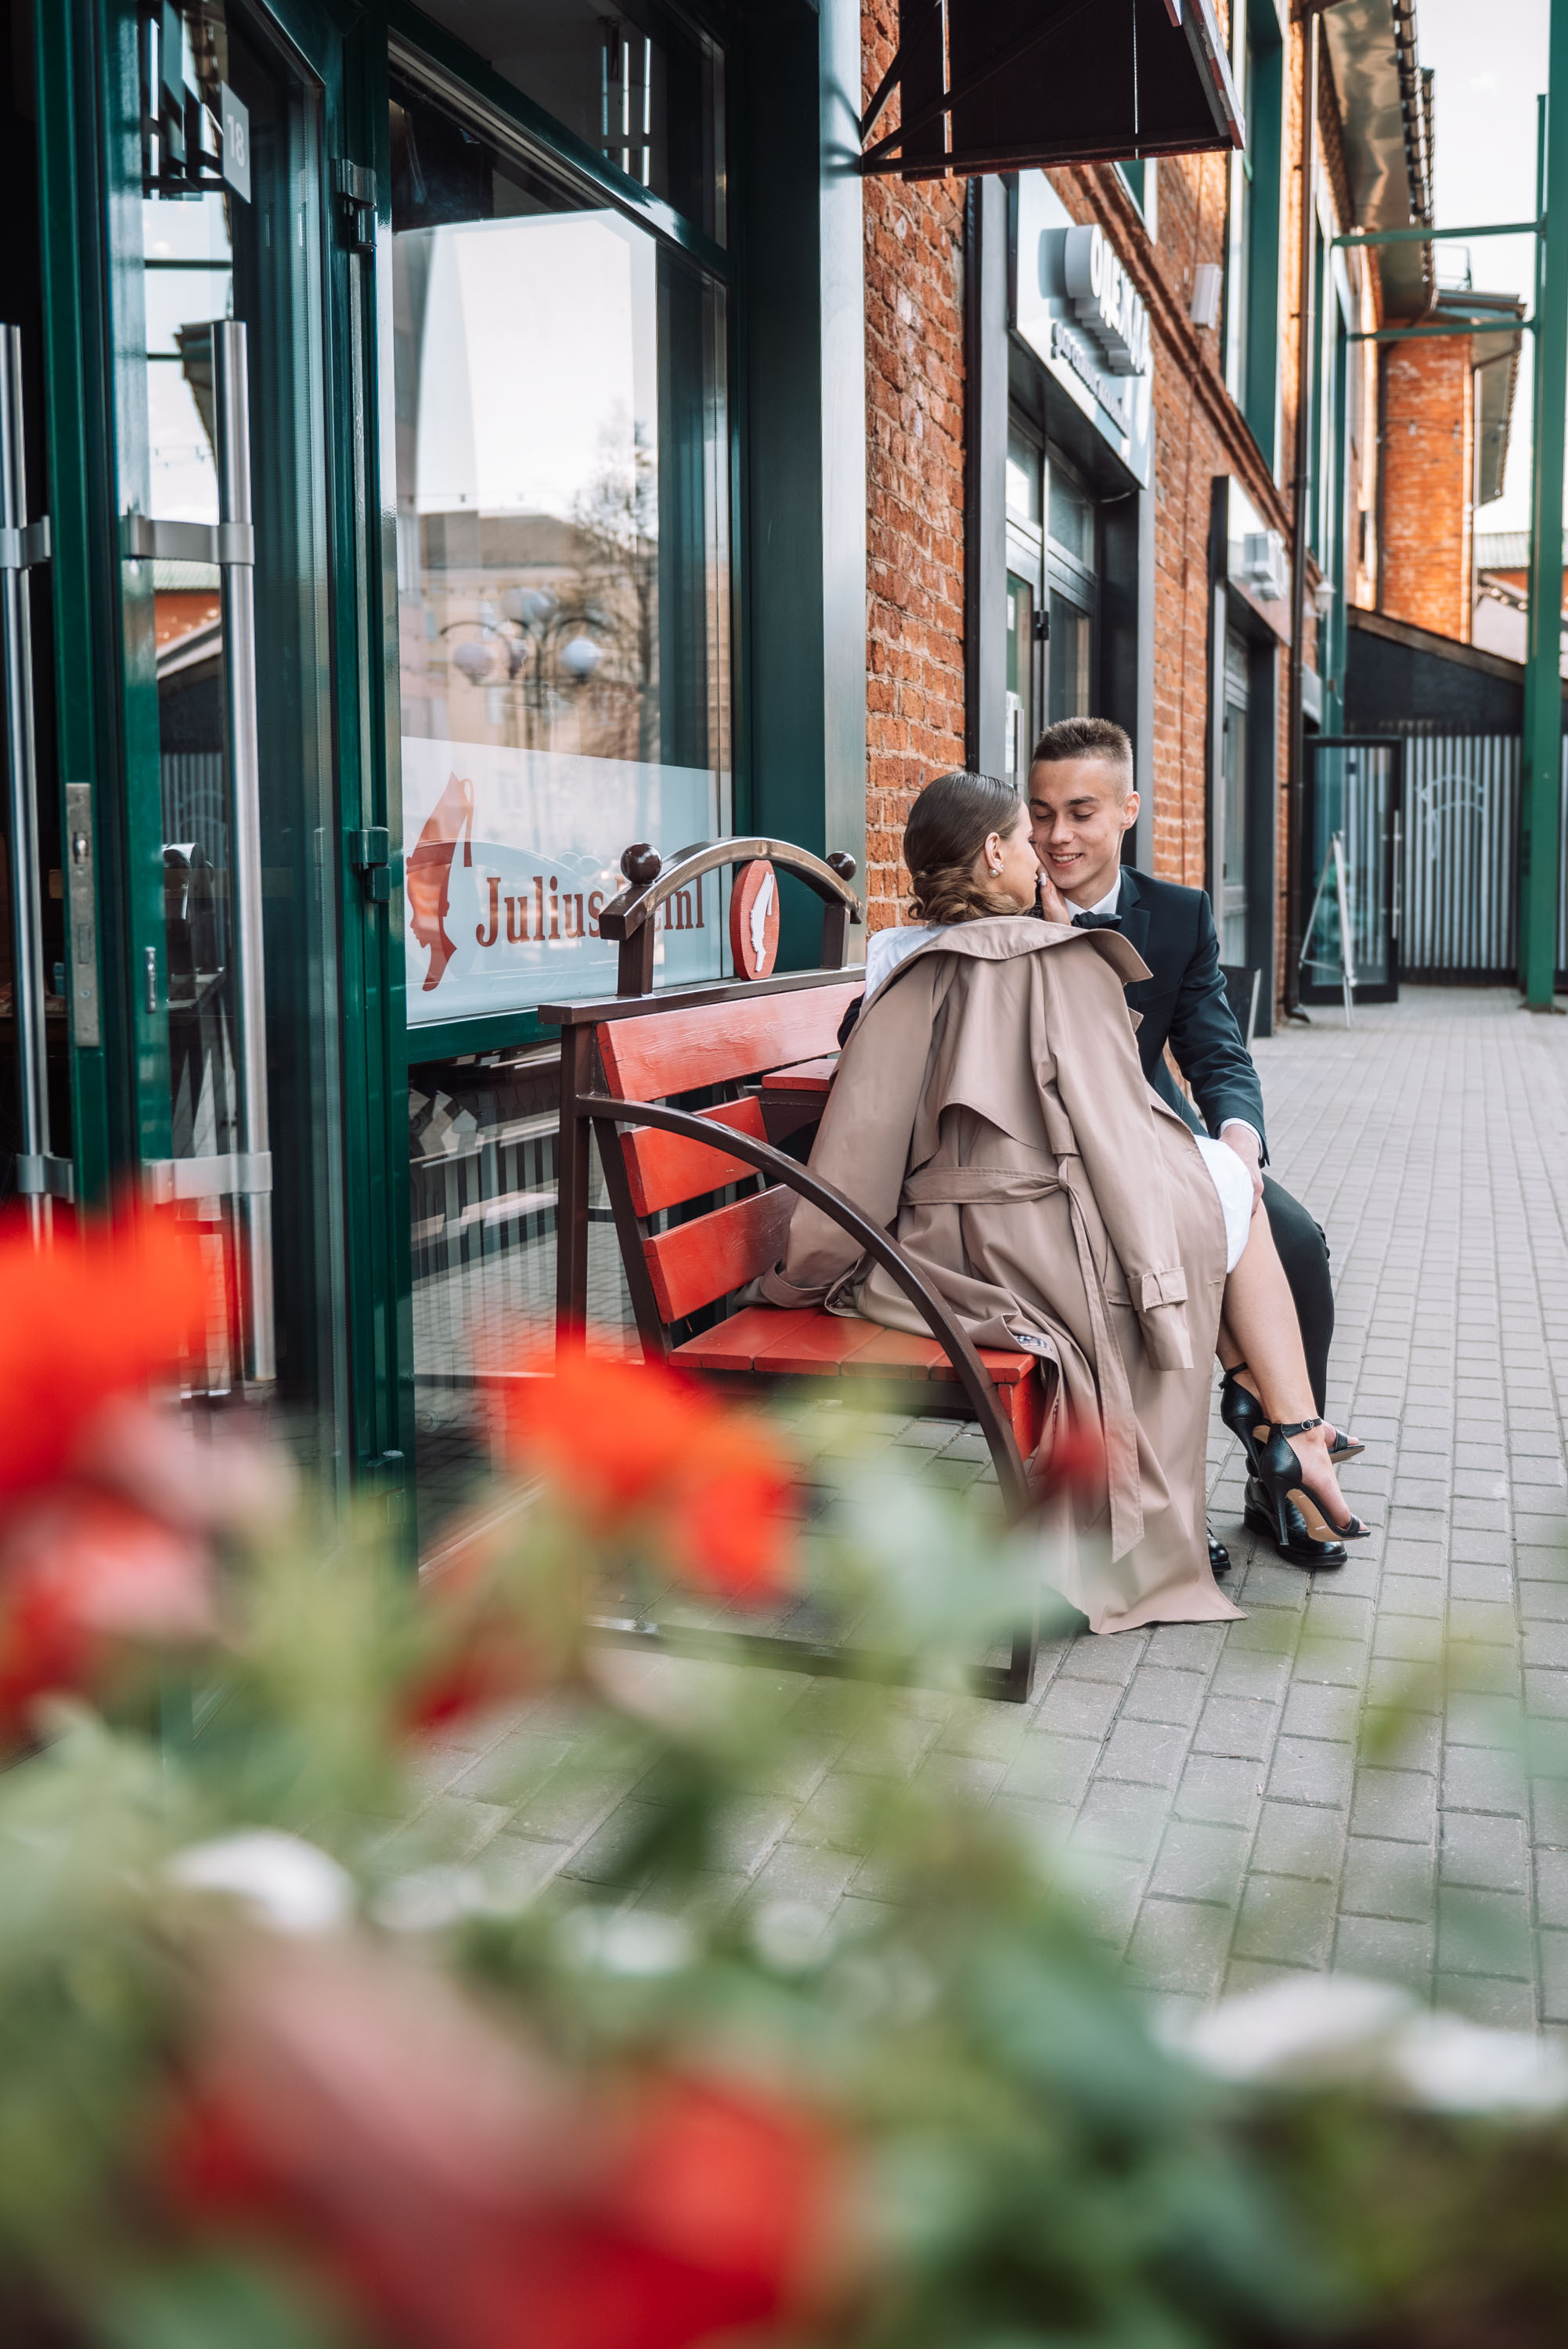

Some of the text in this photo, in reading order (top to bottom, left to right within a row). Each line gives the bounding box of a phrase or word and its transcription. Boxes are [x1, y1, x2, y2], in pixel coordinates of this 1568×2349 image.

[227, 114, 245, 168] 18
[476, 875, 705, 947] Julius inl
